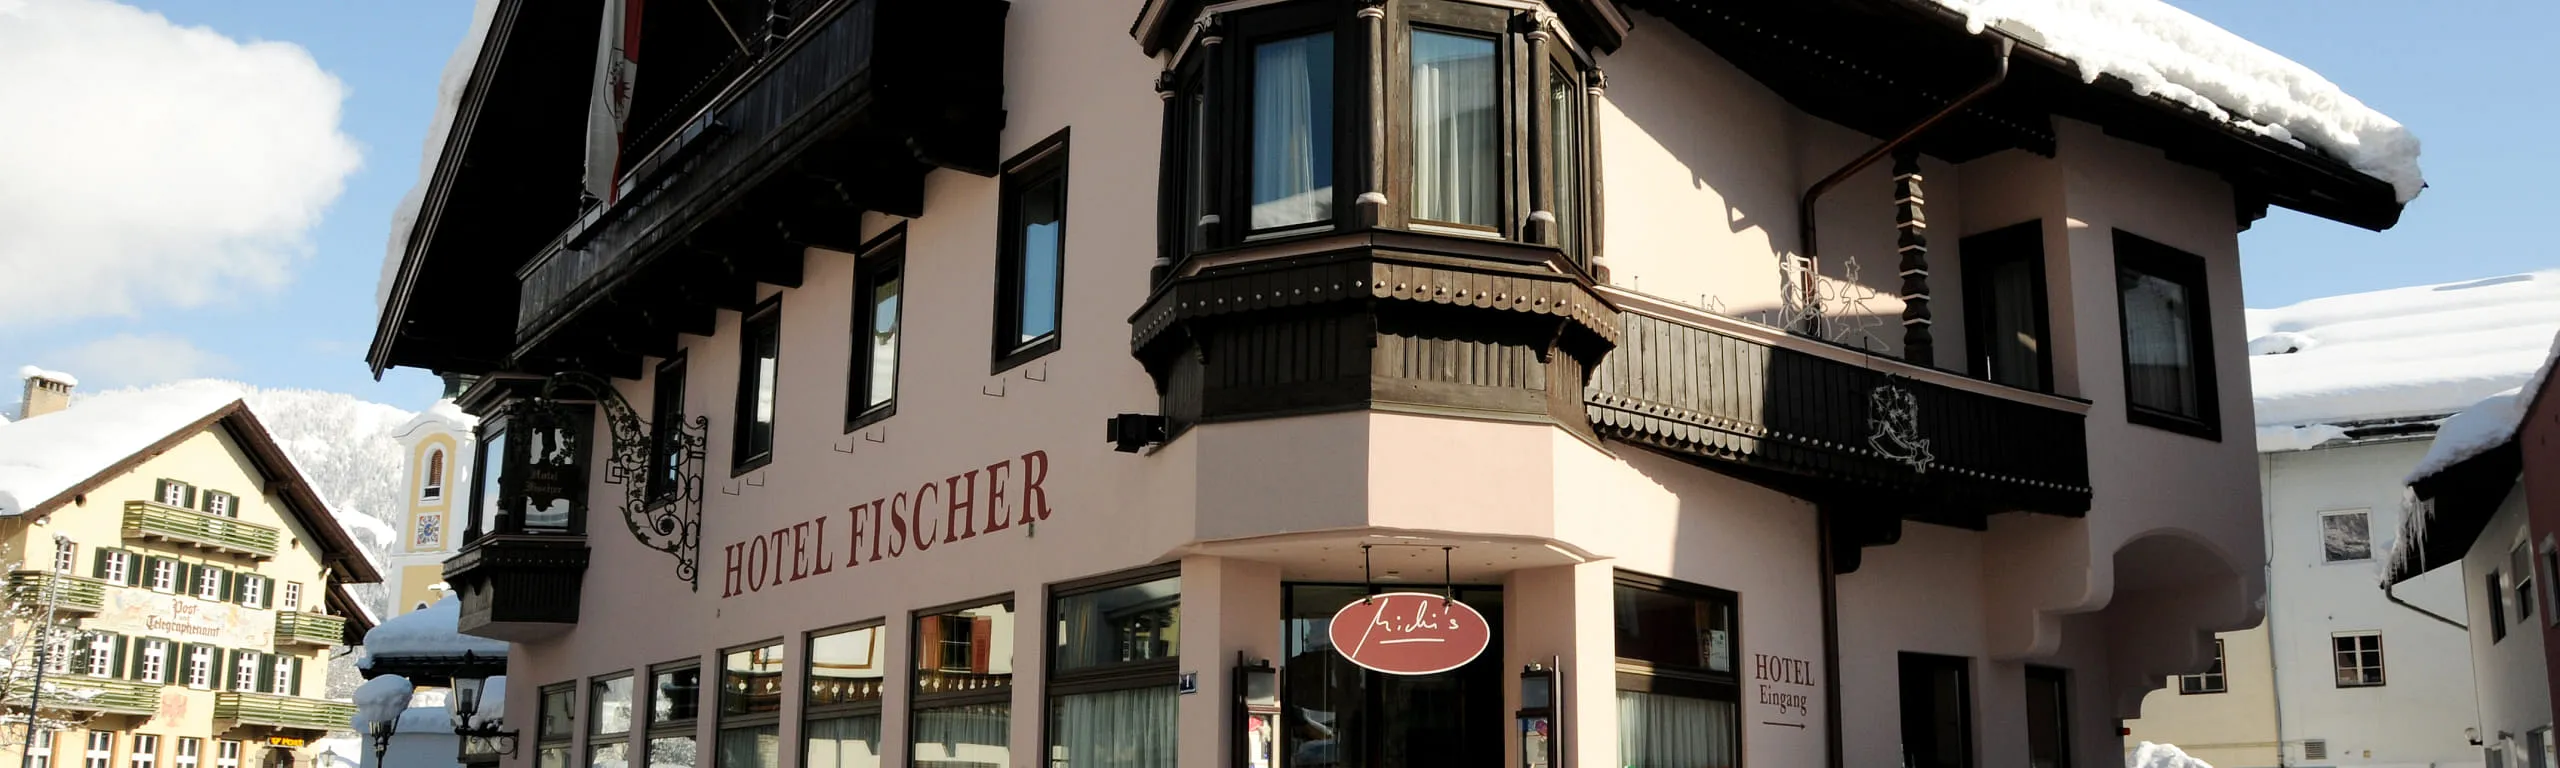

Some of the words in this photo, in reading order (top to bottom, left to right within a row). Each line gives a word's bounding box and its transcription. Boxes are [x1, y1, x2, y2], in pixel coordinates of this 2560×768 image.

[722, 516, 833, 598] HOTEL
[846, 450, 1052, 568] FISCHER
[1755, 654, 1815, 686] HOTEL
[1760, 684, 1807, 716] Eingang
